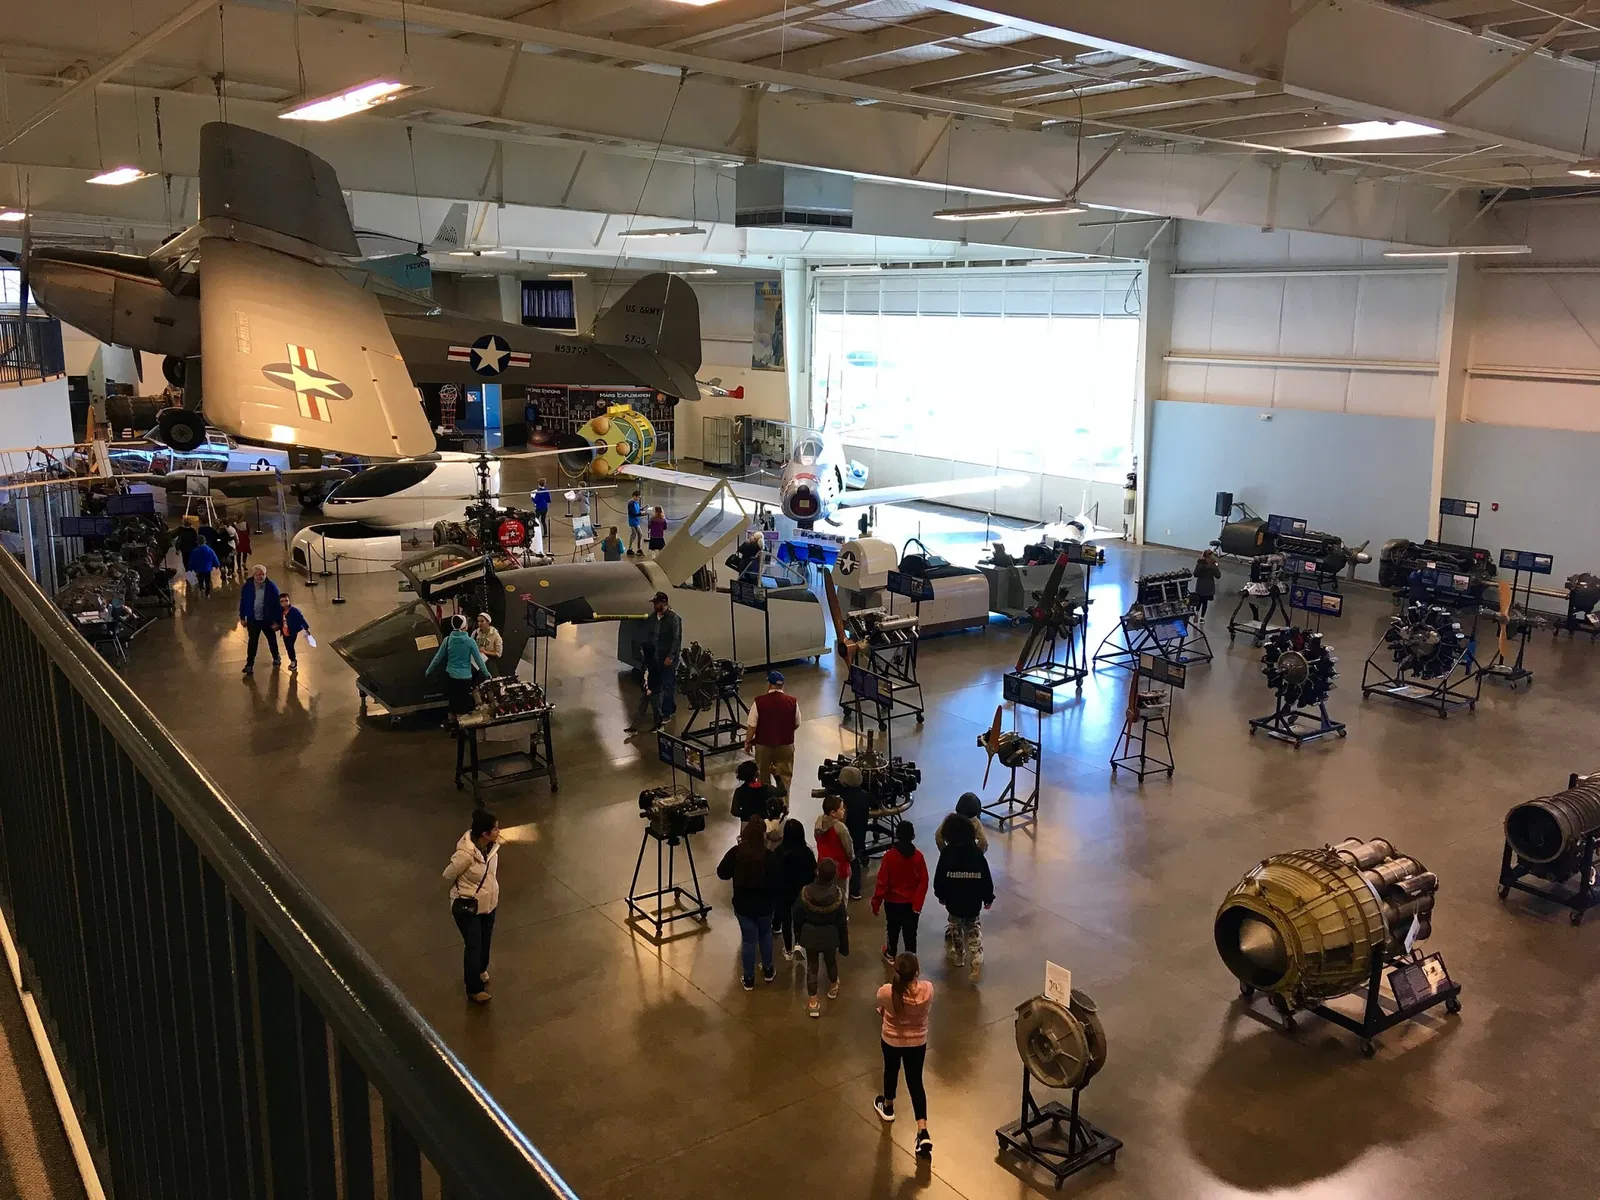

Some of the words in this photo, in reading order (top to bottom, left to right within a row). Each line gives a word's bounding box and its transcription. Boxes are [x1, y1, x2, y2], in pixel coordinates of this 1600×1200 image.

[639, 306, 661, 316] ARMY
[624, 334, 646, 345] 5745
[554, 345, 588, 355] N53792
